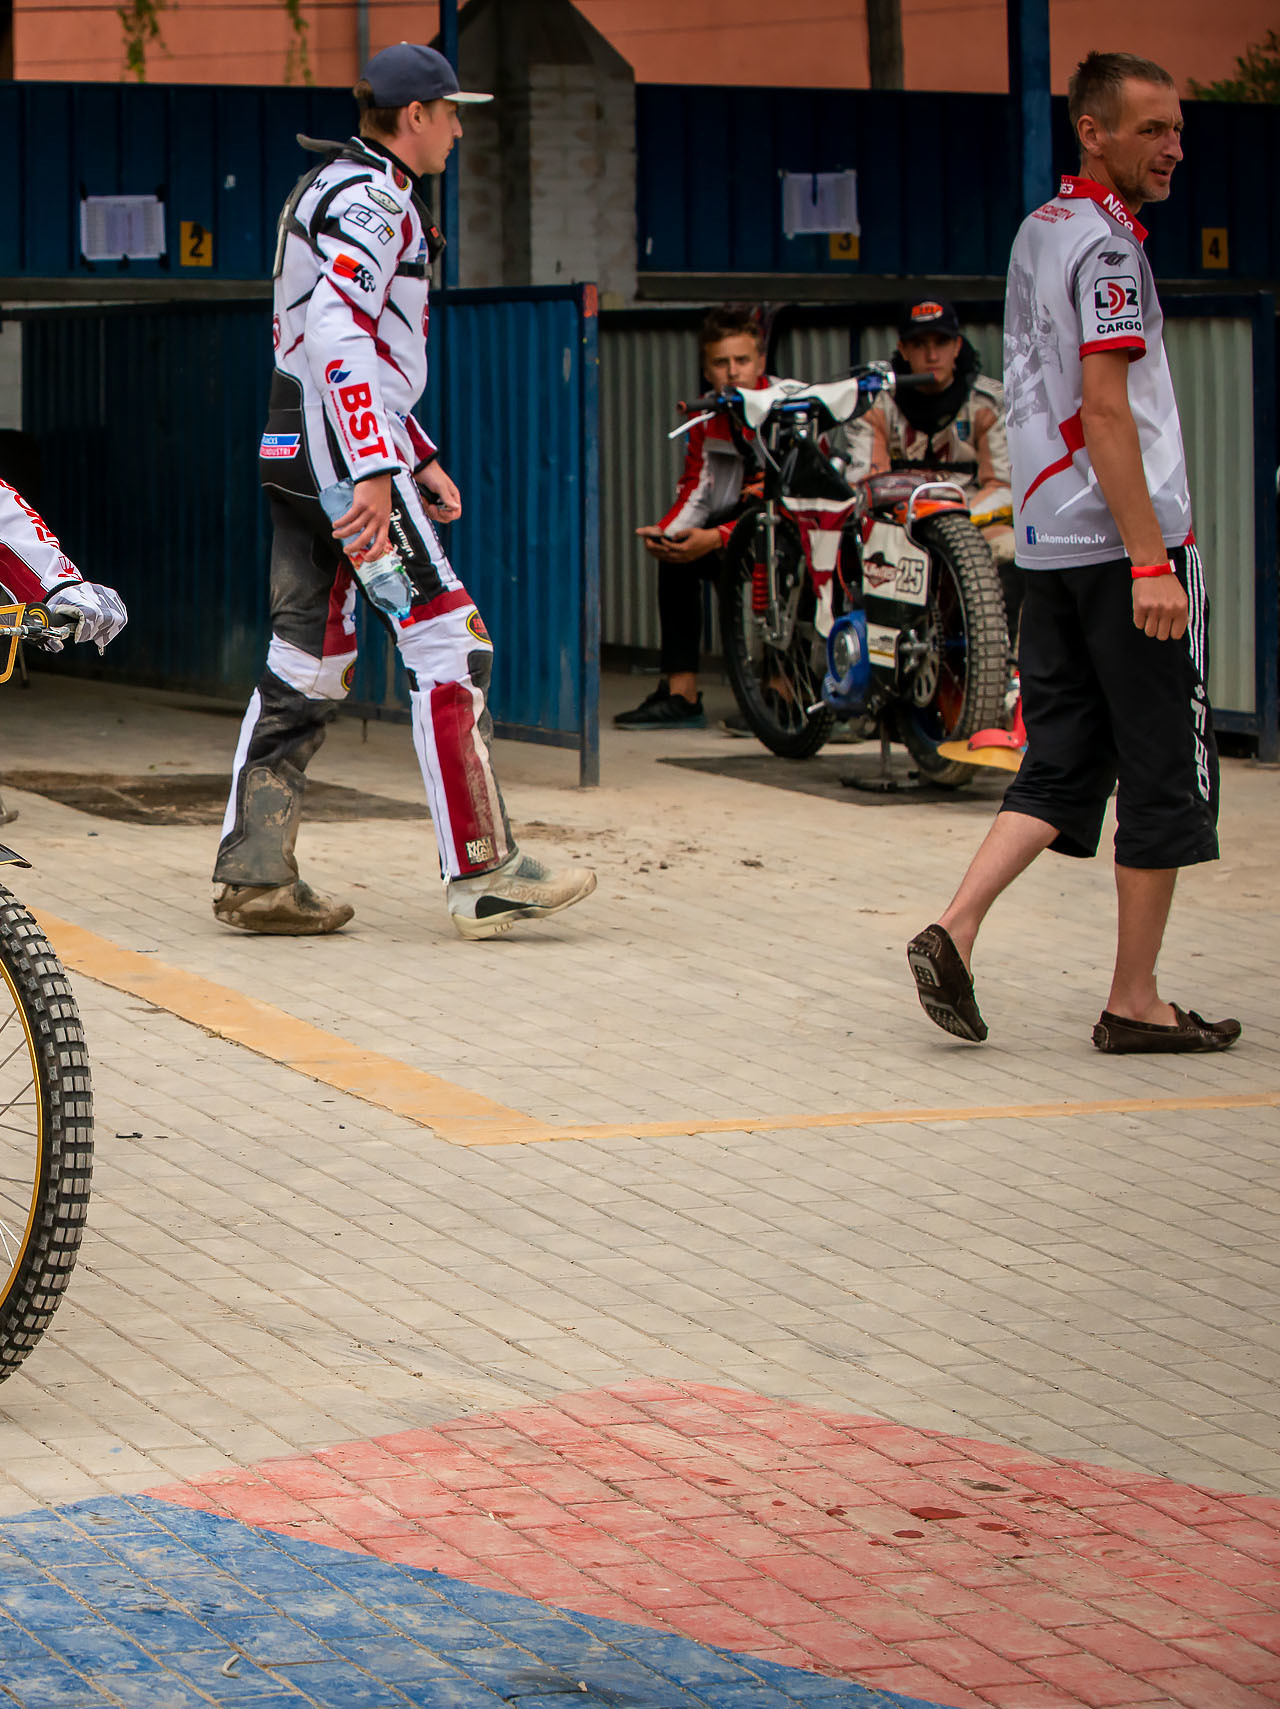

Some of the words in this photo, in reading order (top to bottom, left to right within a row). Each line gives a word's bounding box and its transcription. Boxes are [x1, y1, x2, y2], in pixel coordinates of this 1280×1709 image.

[1103, 193, 1134, 232] Nice
[190, 222, 205, 258] 2
[1209, 237, 1220, 259] 4
[1096, 321, 1142, 334] CARGO
[338, 382, 389, 459] BST
[896, 557, 924, 594] 25
